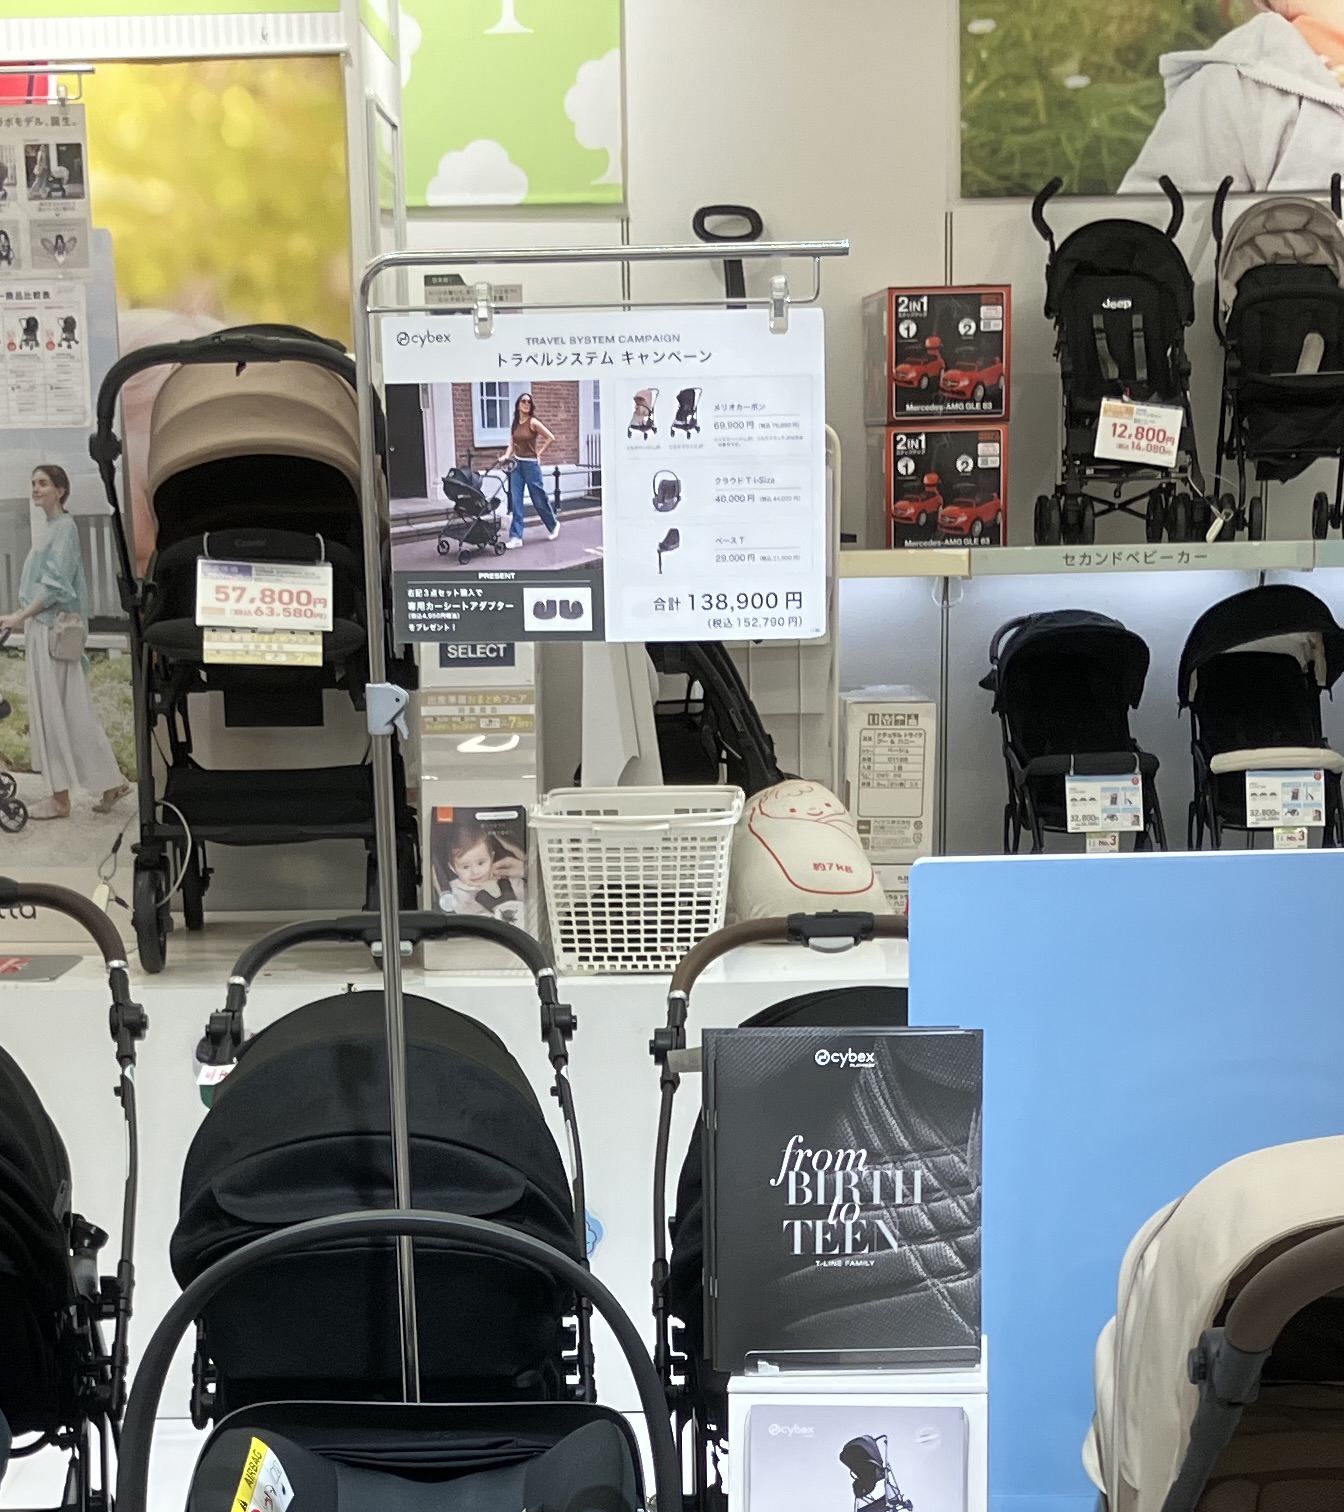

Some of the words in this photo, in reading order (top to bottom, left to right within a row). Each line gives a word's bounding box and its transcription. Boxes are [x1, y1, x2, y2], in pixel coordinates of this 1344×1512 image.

[1102, 299, 1132, 310] Jeep
[411, 331, 451, 349] cybex
[526, 335, 566, 346] TRAVEL
[569, 335, 615, 345] SYSTEM
[618, 333, 681, 344] CAMPAIGN
[496, 351, 614, 367] トラベルシステム
[620, 350, 712, 365] キャンペーン
[714, 403, 766, 411] メリオカーボン
[1111, 422, 1175, 446] 12,800円
[1062, 549, 1208, 568] セカンドベビーカー
[653, 597, 681, 612] 合計
[447, 644, 507, 659] SELECT
[830, 1048, 874, 1068] cybex
[769, 1135, 868, 1187] from
[784, 1170, 922, 1206] BIRTH
[828, 1196, 861, 1224] to
[783, 1219, 899, 1255] TEEN
[780, 1424, 814, 1437] cybex
